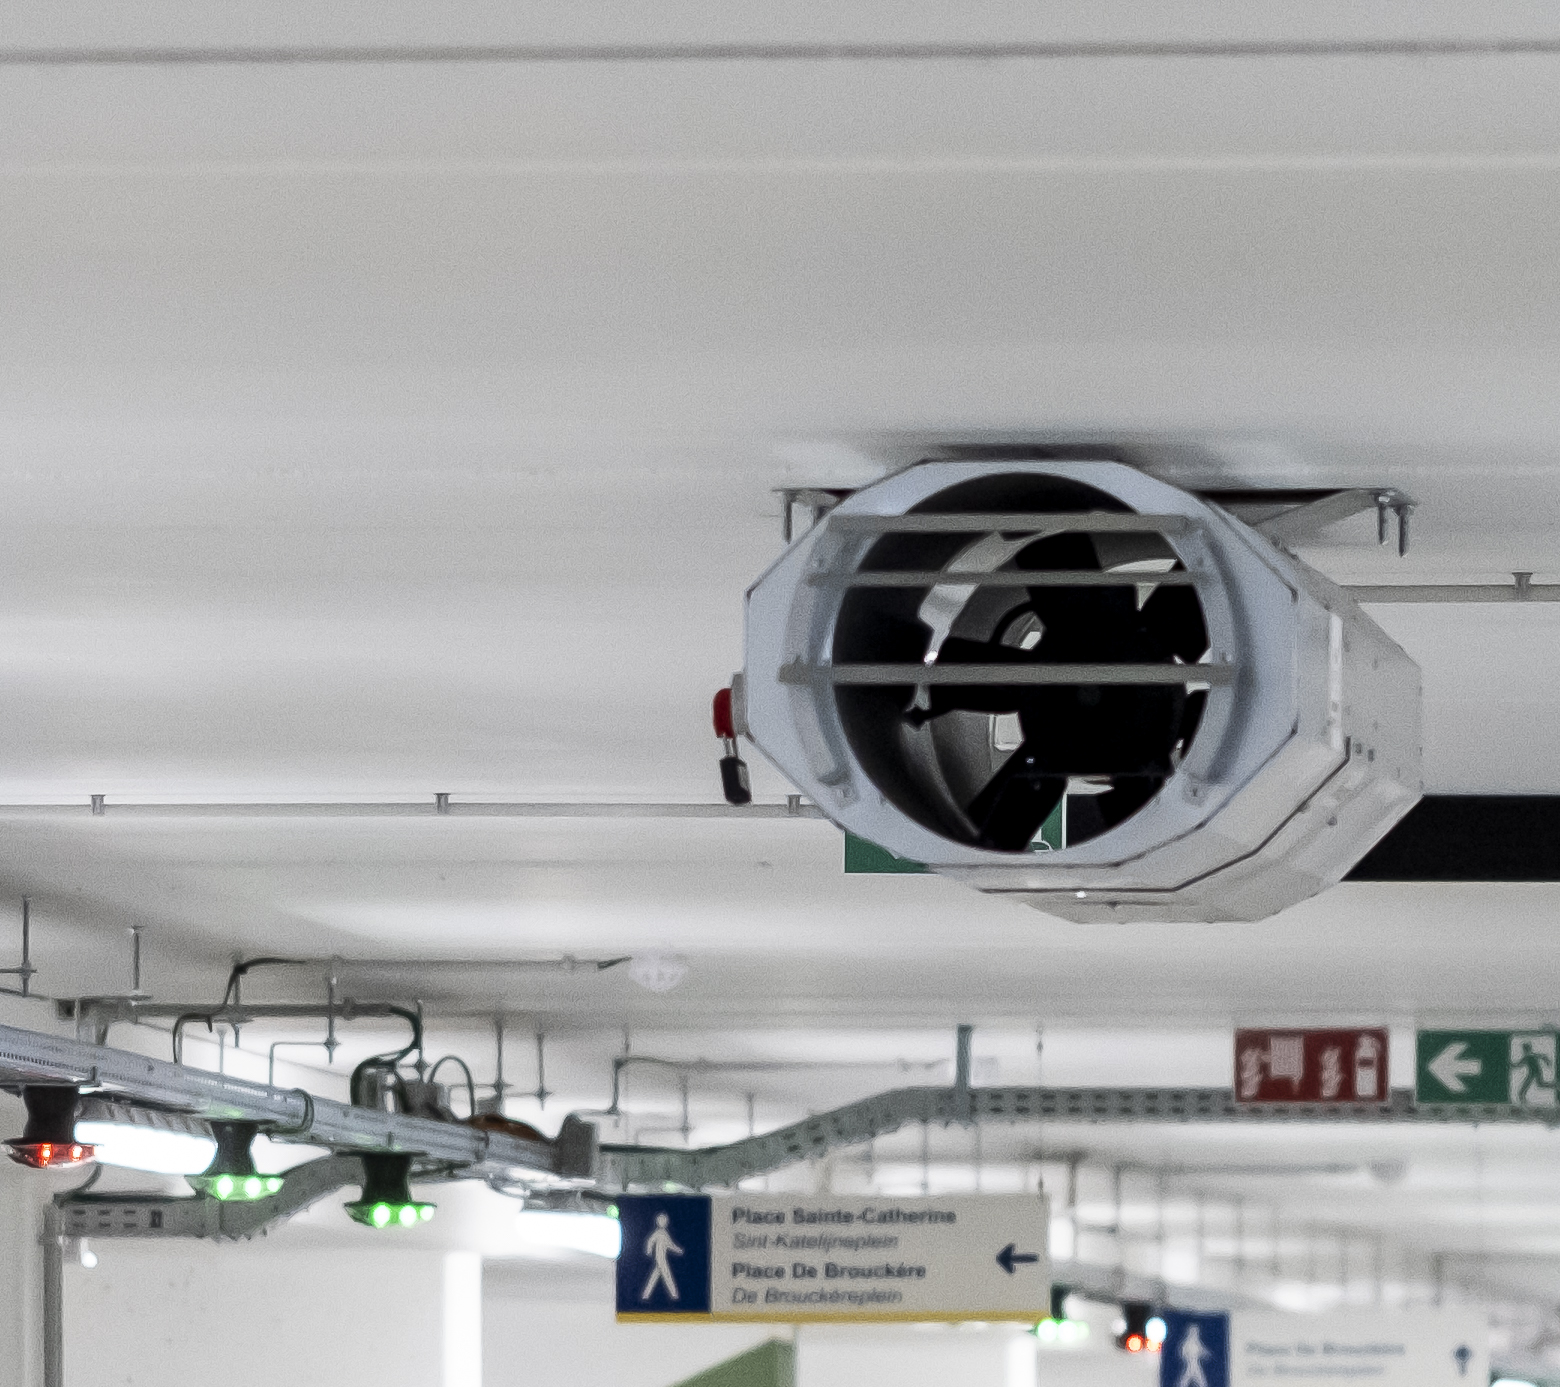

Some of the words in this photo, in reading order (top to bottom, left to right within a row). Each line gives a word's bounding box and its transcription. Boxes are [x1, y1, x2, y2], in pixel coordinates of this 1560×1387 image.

[731, 1206, 785, 1225] Place
[731, 1261, 785, 1280] Place
[791, 1261, 818, 1280] De
